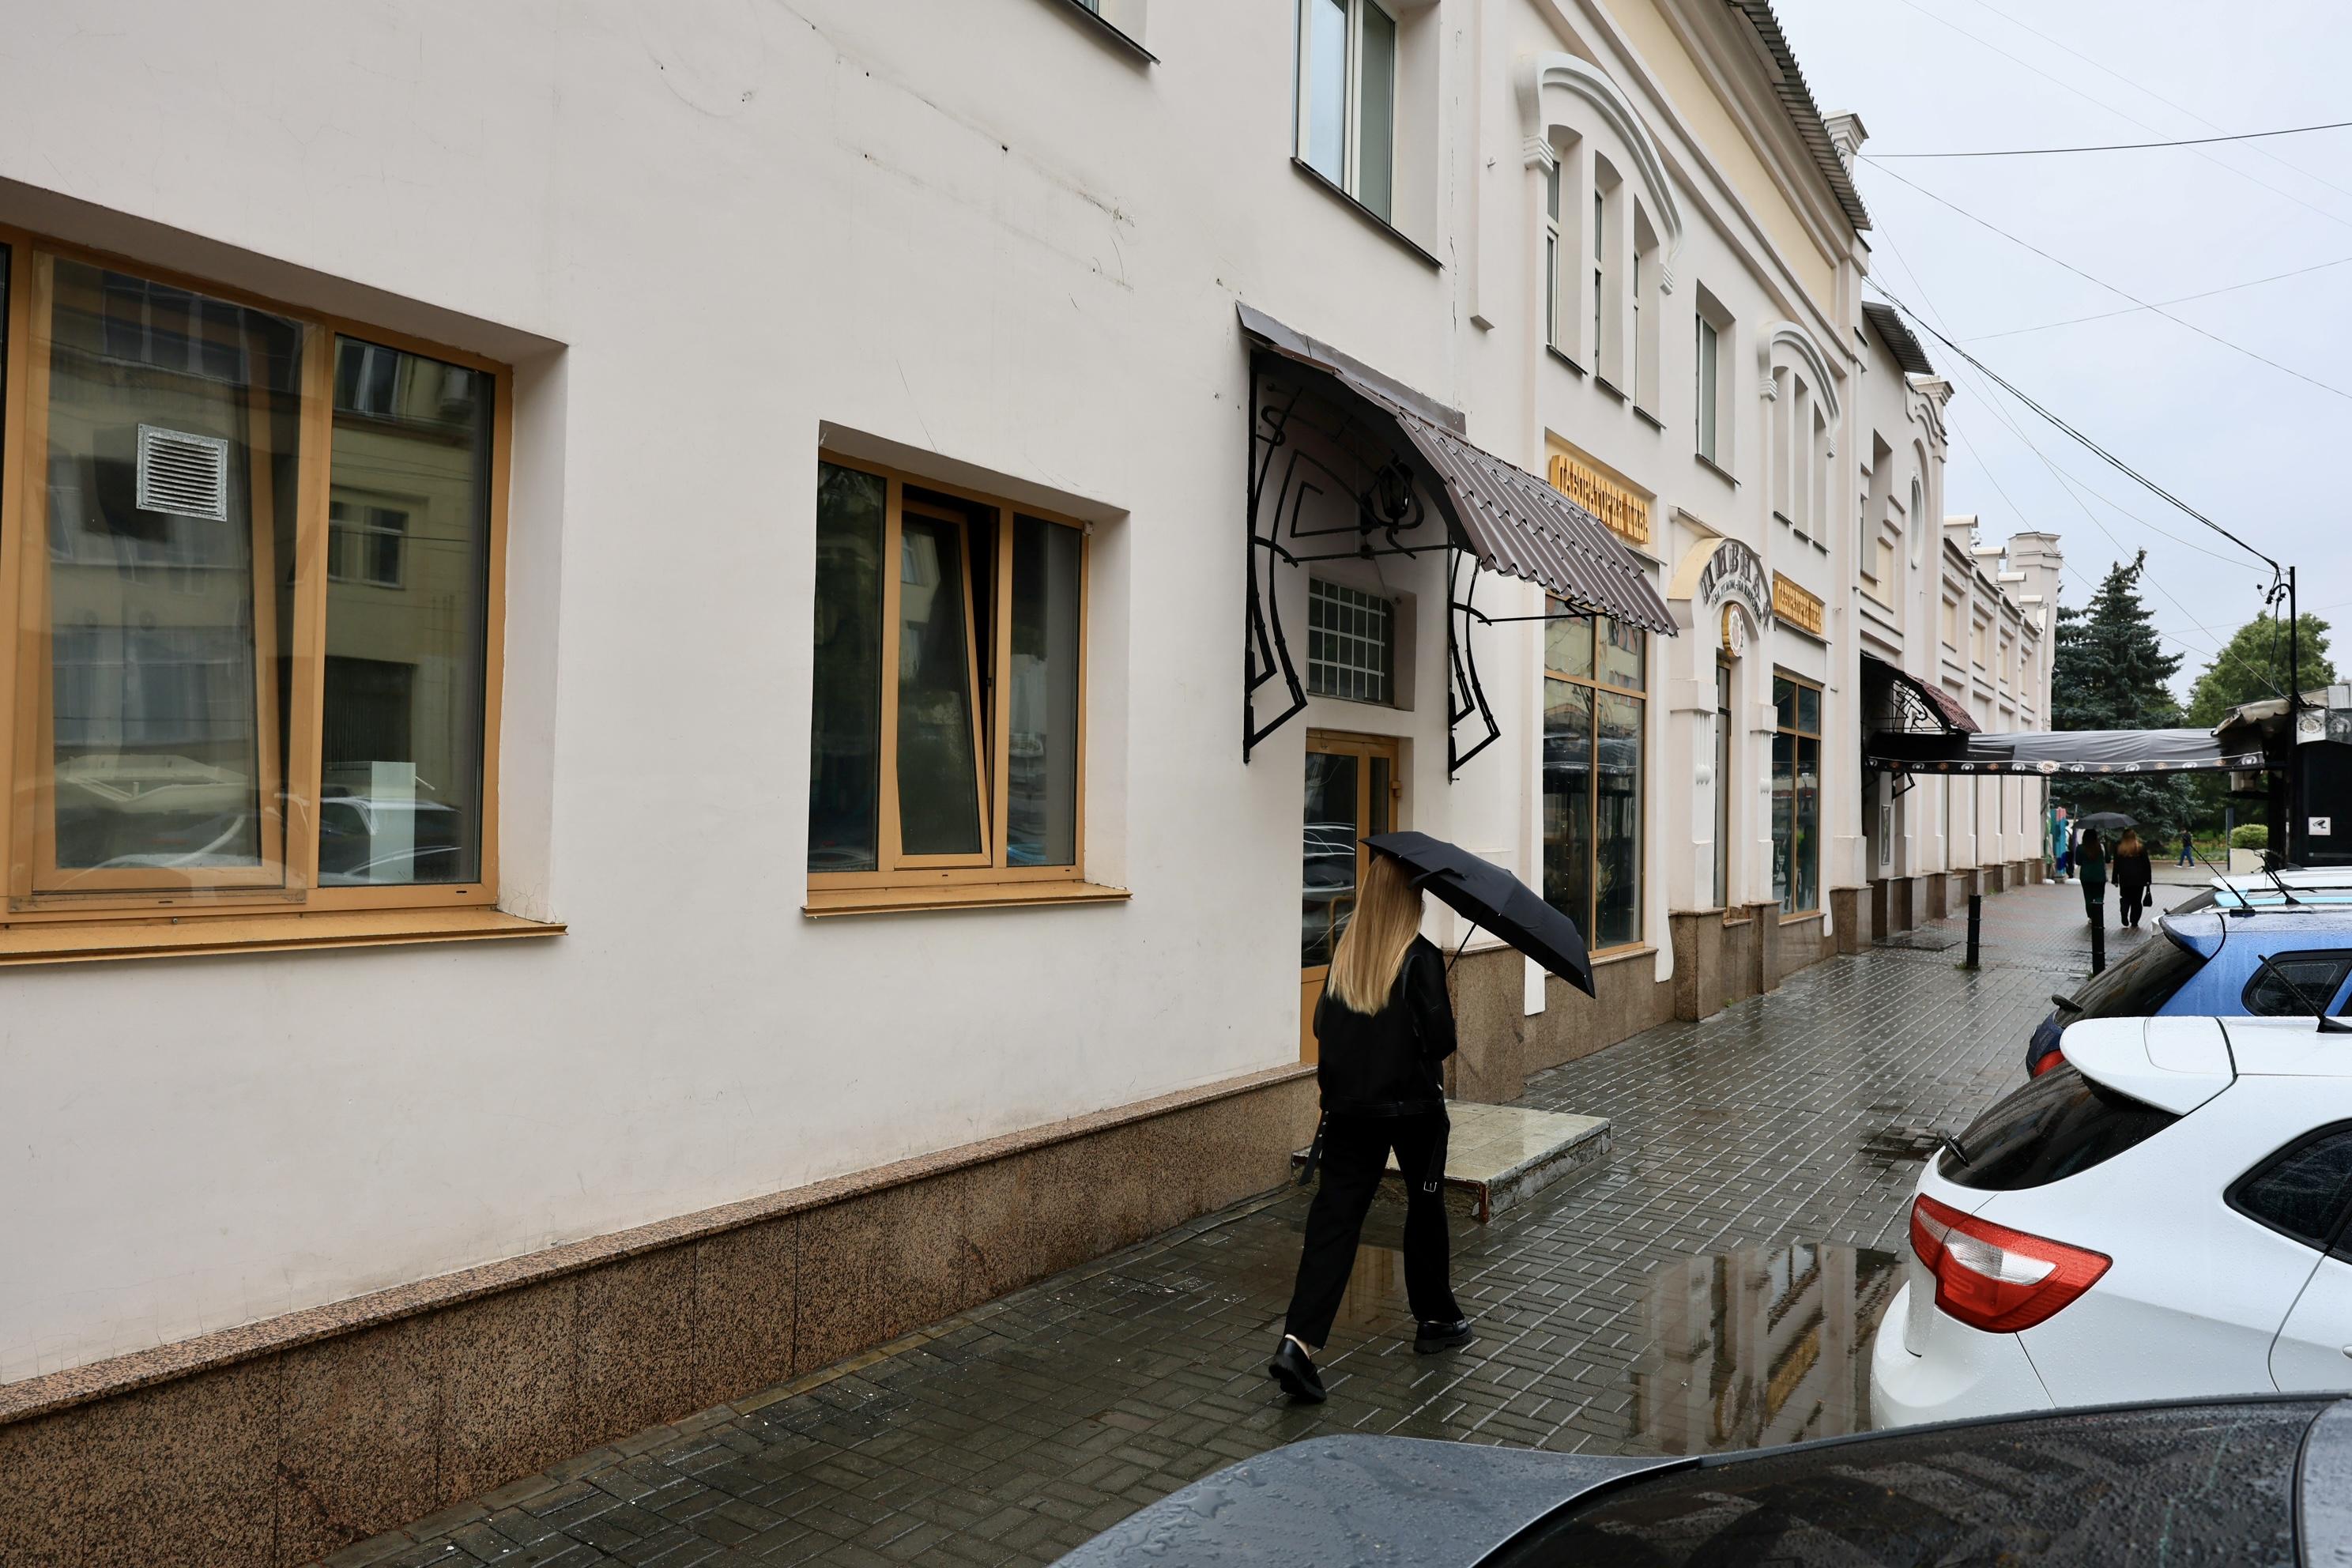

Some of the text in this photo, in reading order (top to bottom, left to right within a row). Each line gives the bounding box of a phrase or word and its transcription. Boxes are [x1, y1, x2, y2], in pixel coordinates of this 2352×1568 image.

[1559, 455, 1650, 544] ЛАБОРАТОРИЯ ПИВА
[1702, 544, 1771, 632] ПИВНАЯ
